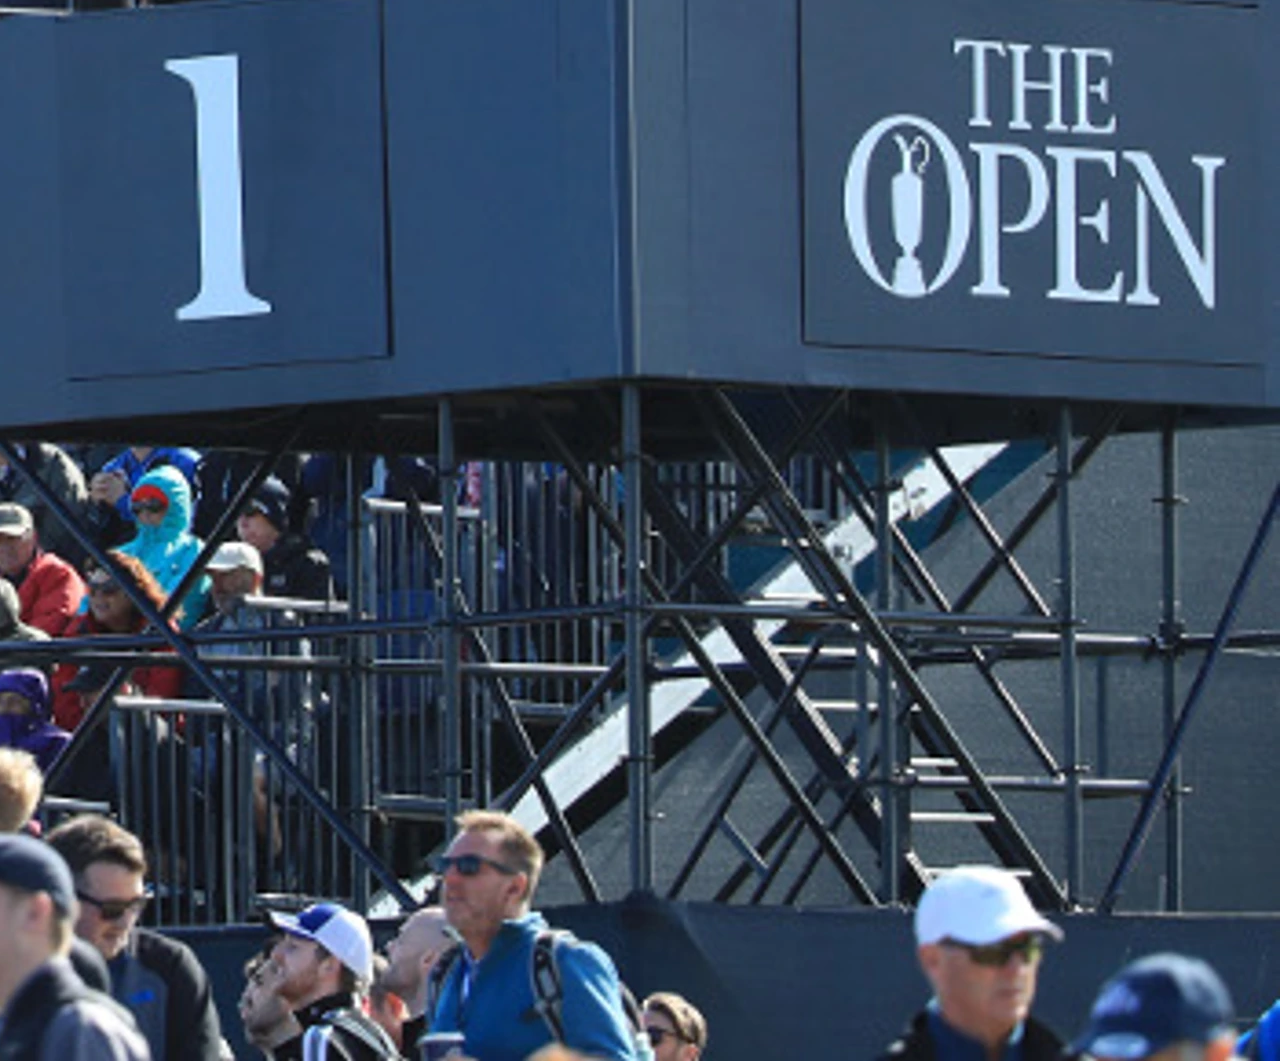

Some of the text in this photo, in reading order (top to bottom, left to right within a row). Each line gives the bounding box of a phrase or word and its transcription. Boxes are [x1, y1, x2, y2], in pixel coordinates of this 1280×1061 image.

[952, 39, 1118, 134] THE
[165, 53, 271, 319] 1
[843, 113, 1228, 310] OPEN
